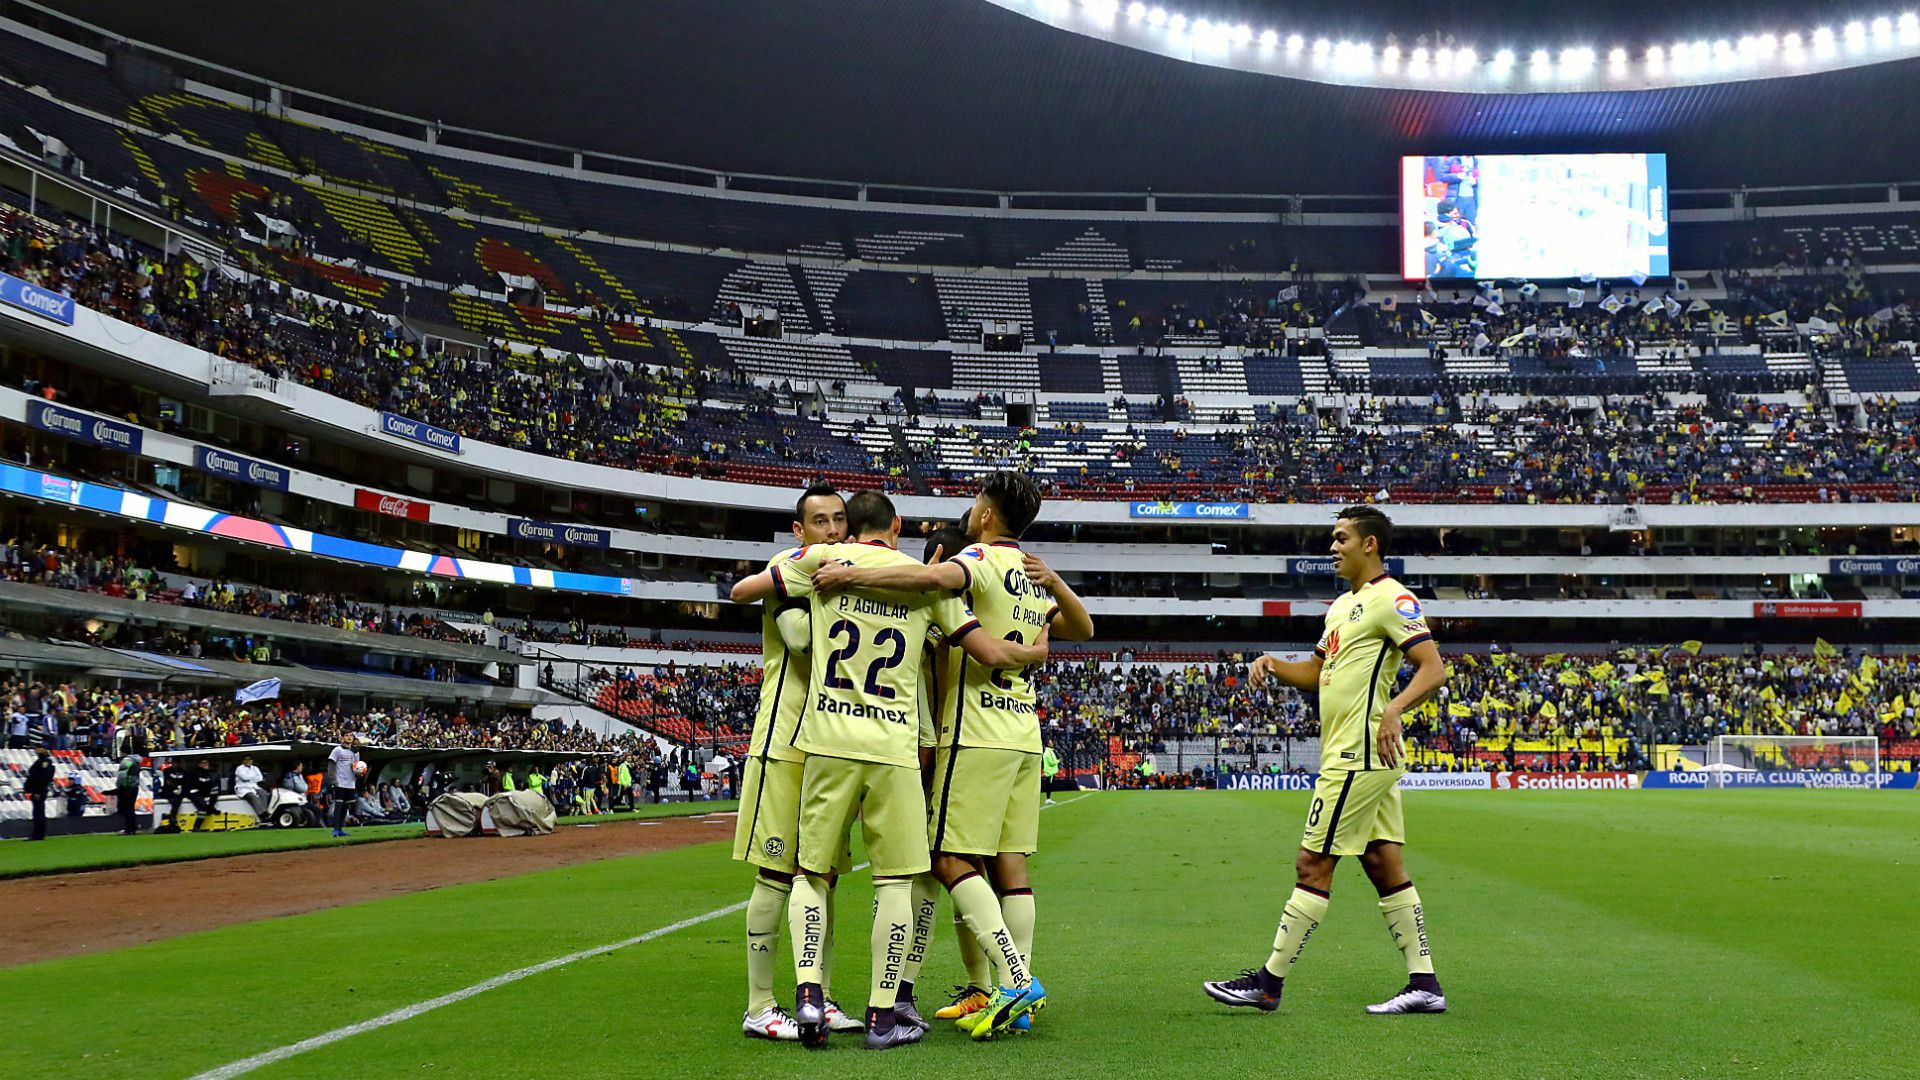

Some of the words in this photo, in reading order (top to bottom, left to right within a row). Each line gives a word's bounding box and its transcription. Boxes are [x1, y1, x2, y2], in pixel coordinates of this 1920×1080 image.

[21, 285, 68, 317] Comex
[41, 406, 82, 433] Corona
[93, 420, 132, 444] Corona
[387, 416, 418, 437] Comex
[426, 428, 456, 448] Comex
[205, 451, 240, 473] Corona
[248, 462, 280, 482] Corona
[1196, 503, 1242, 516] Comex
[518, 521, 554, 538] Corona
[564, 527, 599, 543] Corona
[1839, 560, 1883, 573] Corona
[839, 595, 849, 612] P.
[853, 598, 909, 620] AGUILAR
[1023, 608, 1044, 628] PERAL
[824, 618, 907, 700] 22
[816, 692, 908, 725] Banamex
[980, 691, 1036, 714] Banam
[1227, 774, 1311, 790] JARRITOS
[1398, 779, 1413, 787] RA
[1414, 779, 1427, 787] LA
[1429, 778, 1485, 787] DIVERSIDAD
[1517, 773, 1628, 789] Scotiabank
[1669, 772, 1709, 784] ROAD
[1714, 772, 1733, 784] TO
[1737, 772, 1765, 784] FIFA
[1769, 772, 1806, 784] CLUB
[1809, 772, 1861, 785] WORLD
[1865, 773, 1894, 785] CUP
[1309, 797, 1324, 827] 8
[798, 905, 821, 968] Banamex
[906, 898, 936, 963] Banamex
[880, 922, 907, 990] Banamex
